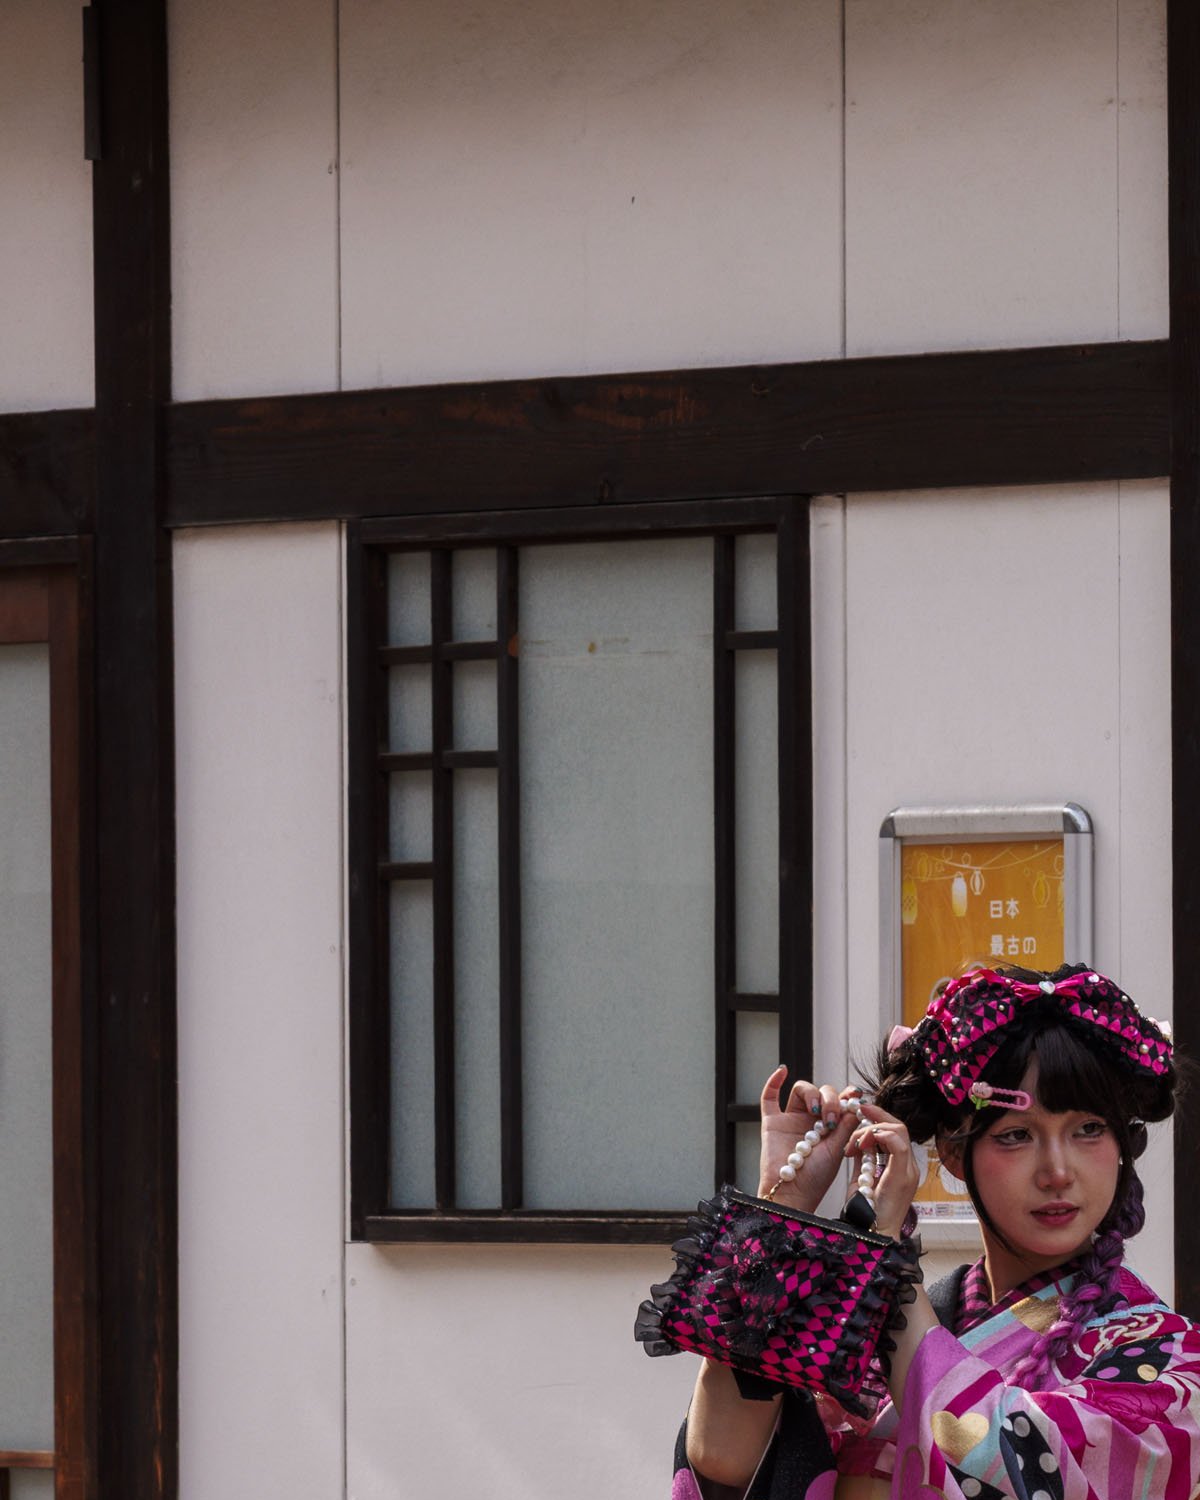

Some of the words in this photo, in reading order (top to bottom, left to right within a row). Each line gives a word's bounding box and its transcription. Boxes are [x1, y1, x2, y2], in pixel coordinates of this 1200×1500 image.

[990, 898, 1020, 919] 日本
[990, 934, 1036, 956] 最古の
